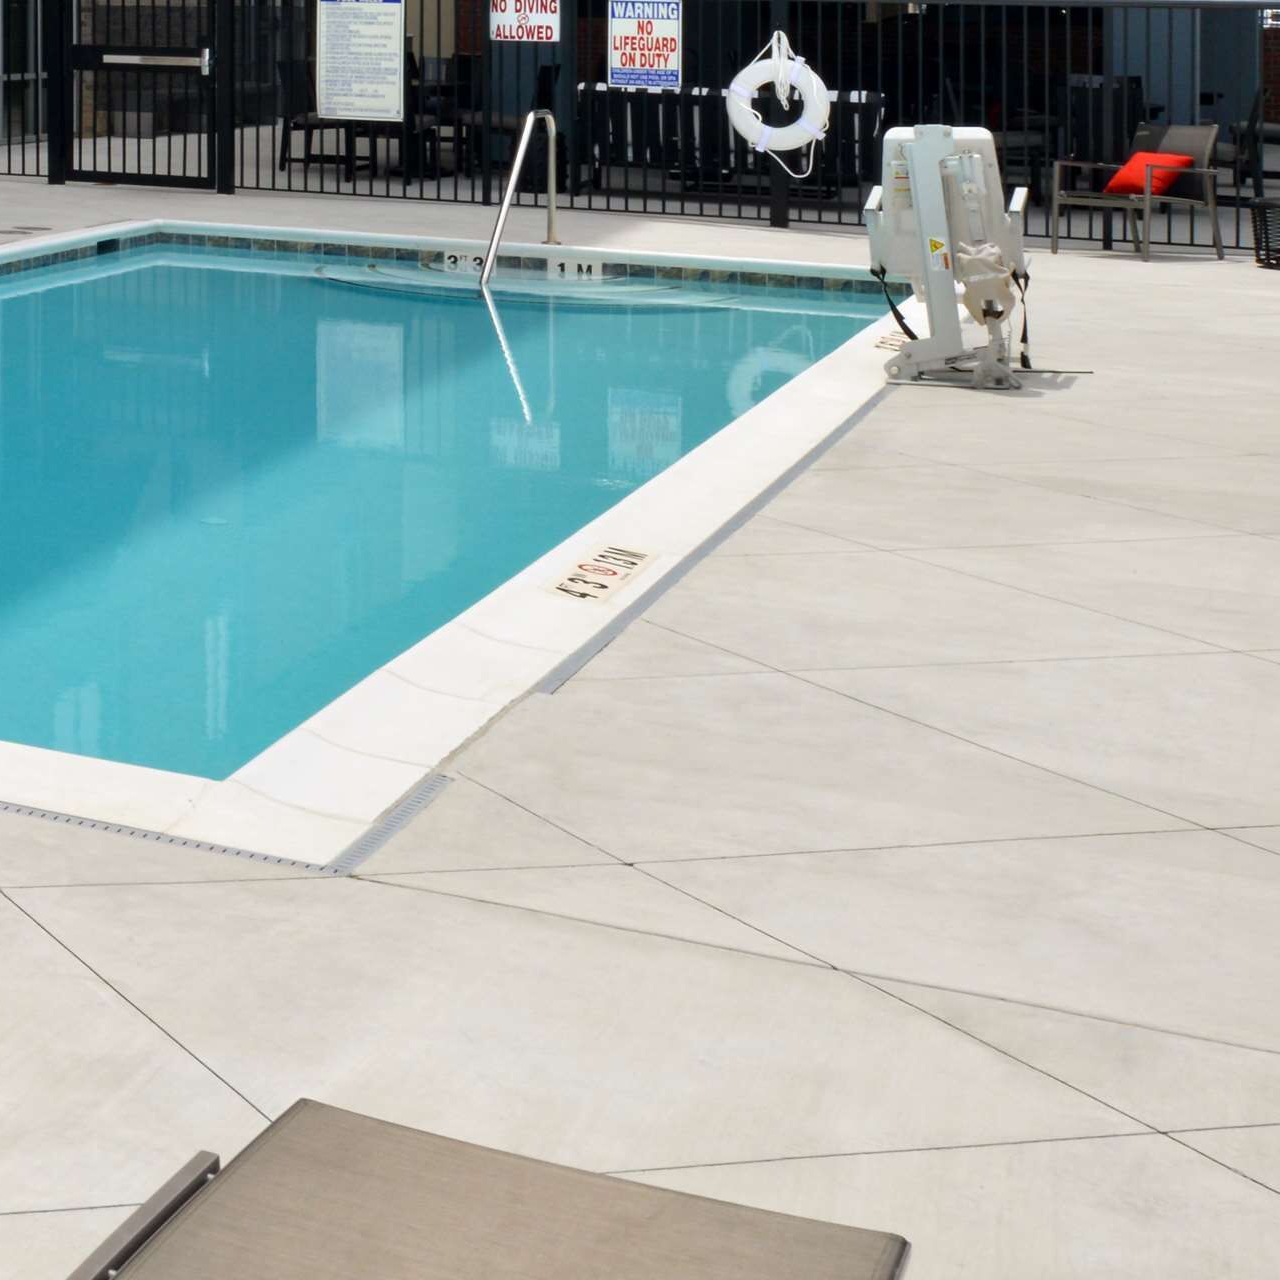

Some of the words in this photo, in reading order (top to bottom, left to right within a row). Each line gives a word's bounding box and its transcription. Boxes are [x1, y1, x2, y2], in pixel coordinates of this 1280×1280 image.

[613, 2, 678, 18] WARNING
[495, 24, 553, 40] ALLOWED
[637, 20, 653, 35] NO
[613, 36, 677, 52] LIFEGUARD
[621, 52, 636, 67] ON
[640, 53, 669, 68] DUTY
